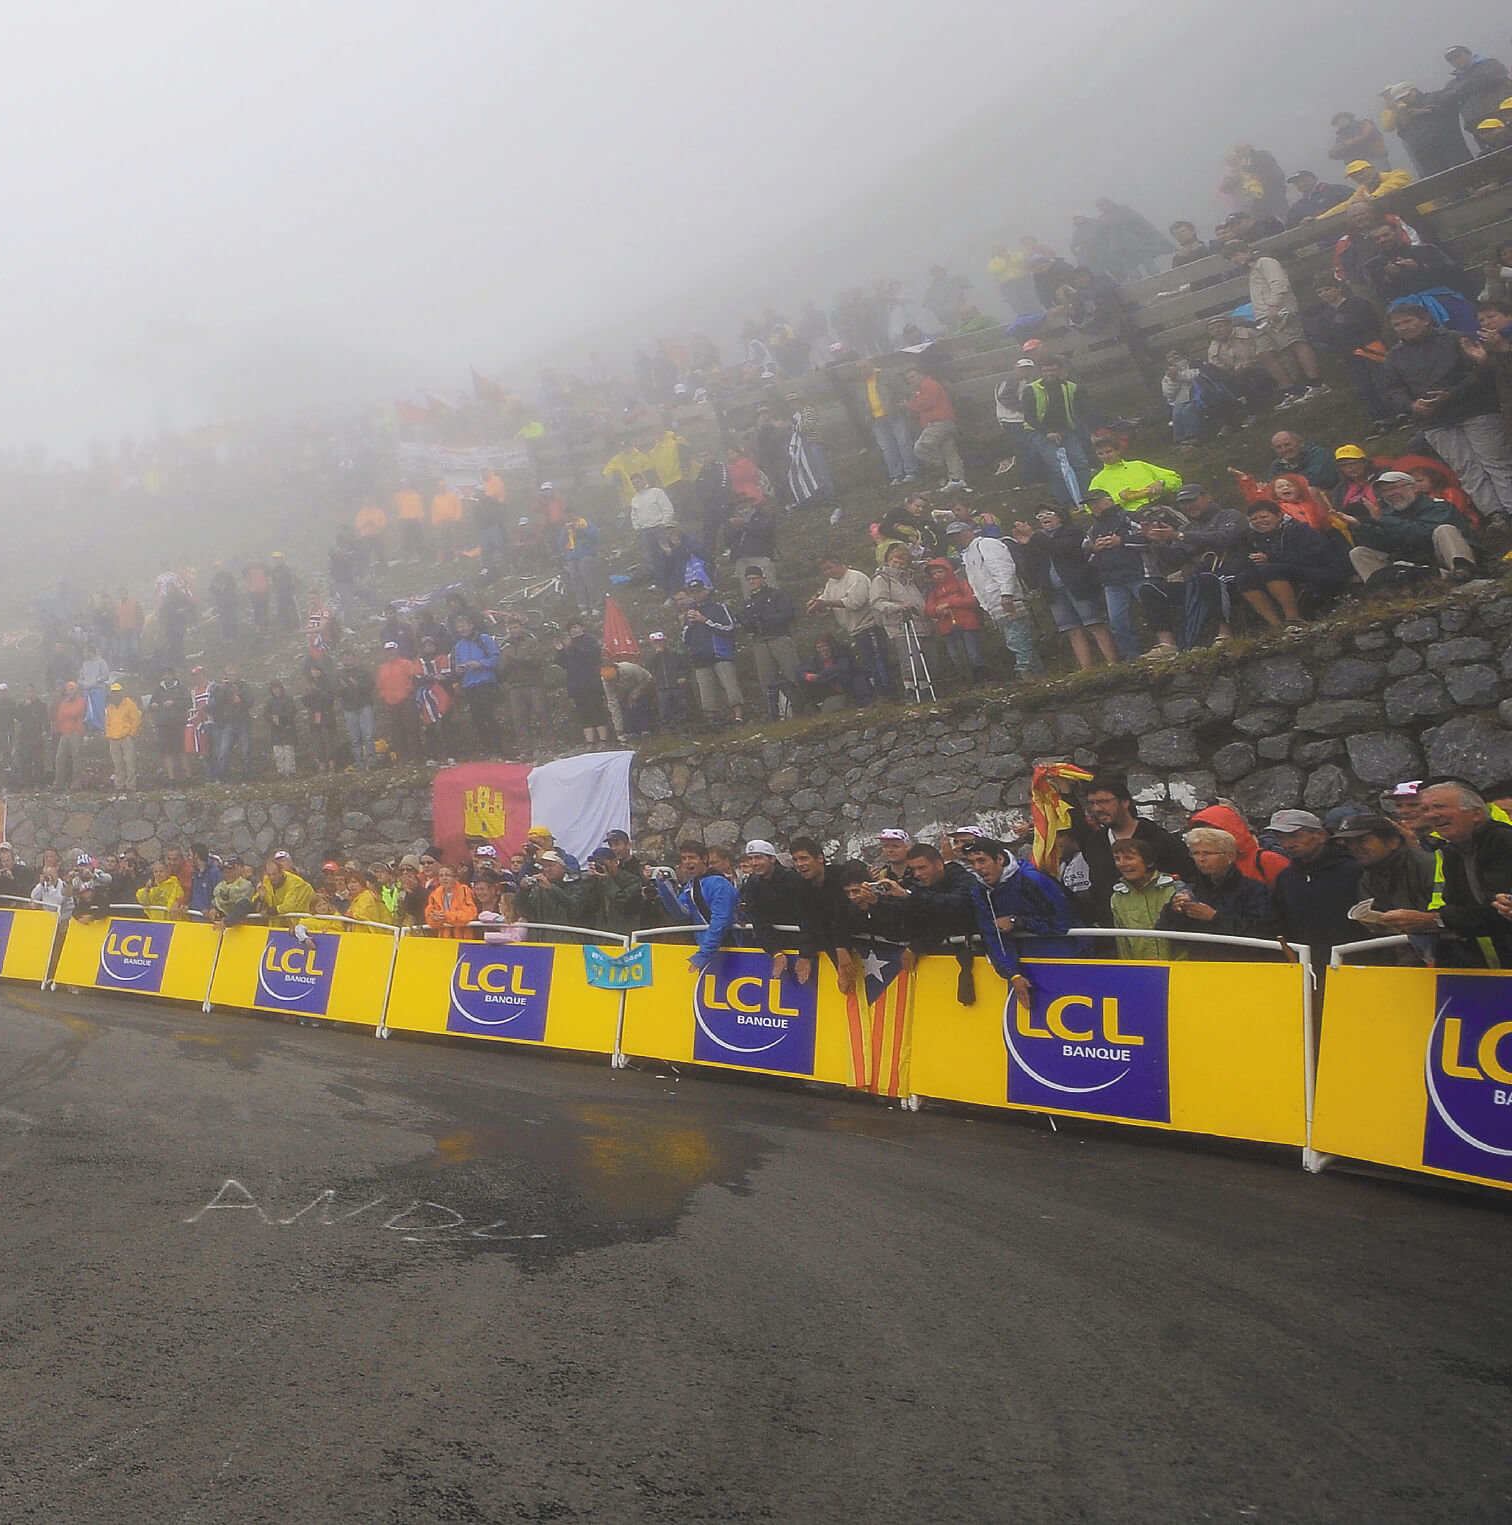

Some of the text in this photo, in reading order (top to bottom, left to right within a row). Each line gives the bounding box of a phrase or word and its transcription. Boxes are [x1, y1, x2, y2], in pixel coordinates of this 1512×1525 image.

[106, 933, 159, 959] LCL
[123, 957, 152, 967] BANQUE
[265, 946, 324, 976] LCL
[284, 973, 317, 985] BANQUE
[458, 962, 536, 996] LCL
[484, 994, 527, 1006] BANQUE
[703, 974, 800, 1017] LCL
[737, 1015, 788, 1029] BANQUE
[1016, 995, 1144, 1046] LCL
[1062, 1045, 1131, 1061] BANQUE
[1442, 1017, 1512, 1085] LC
